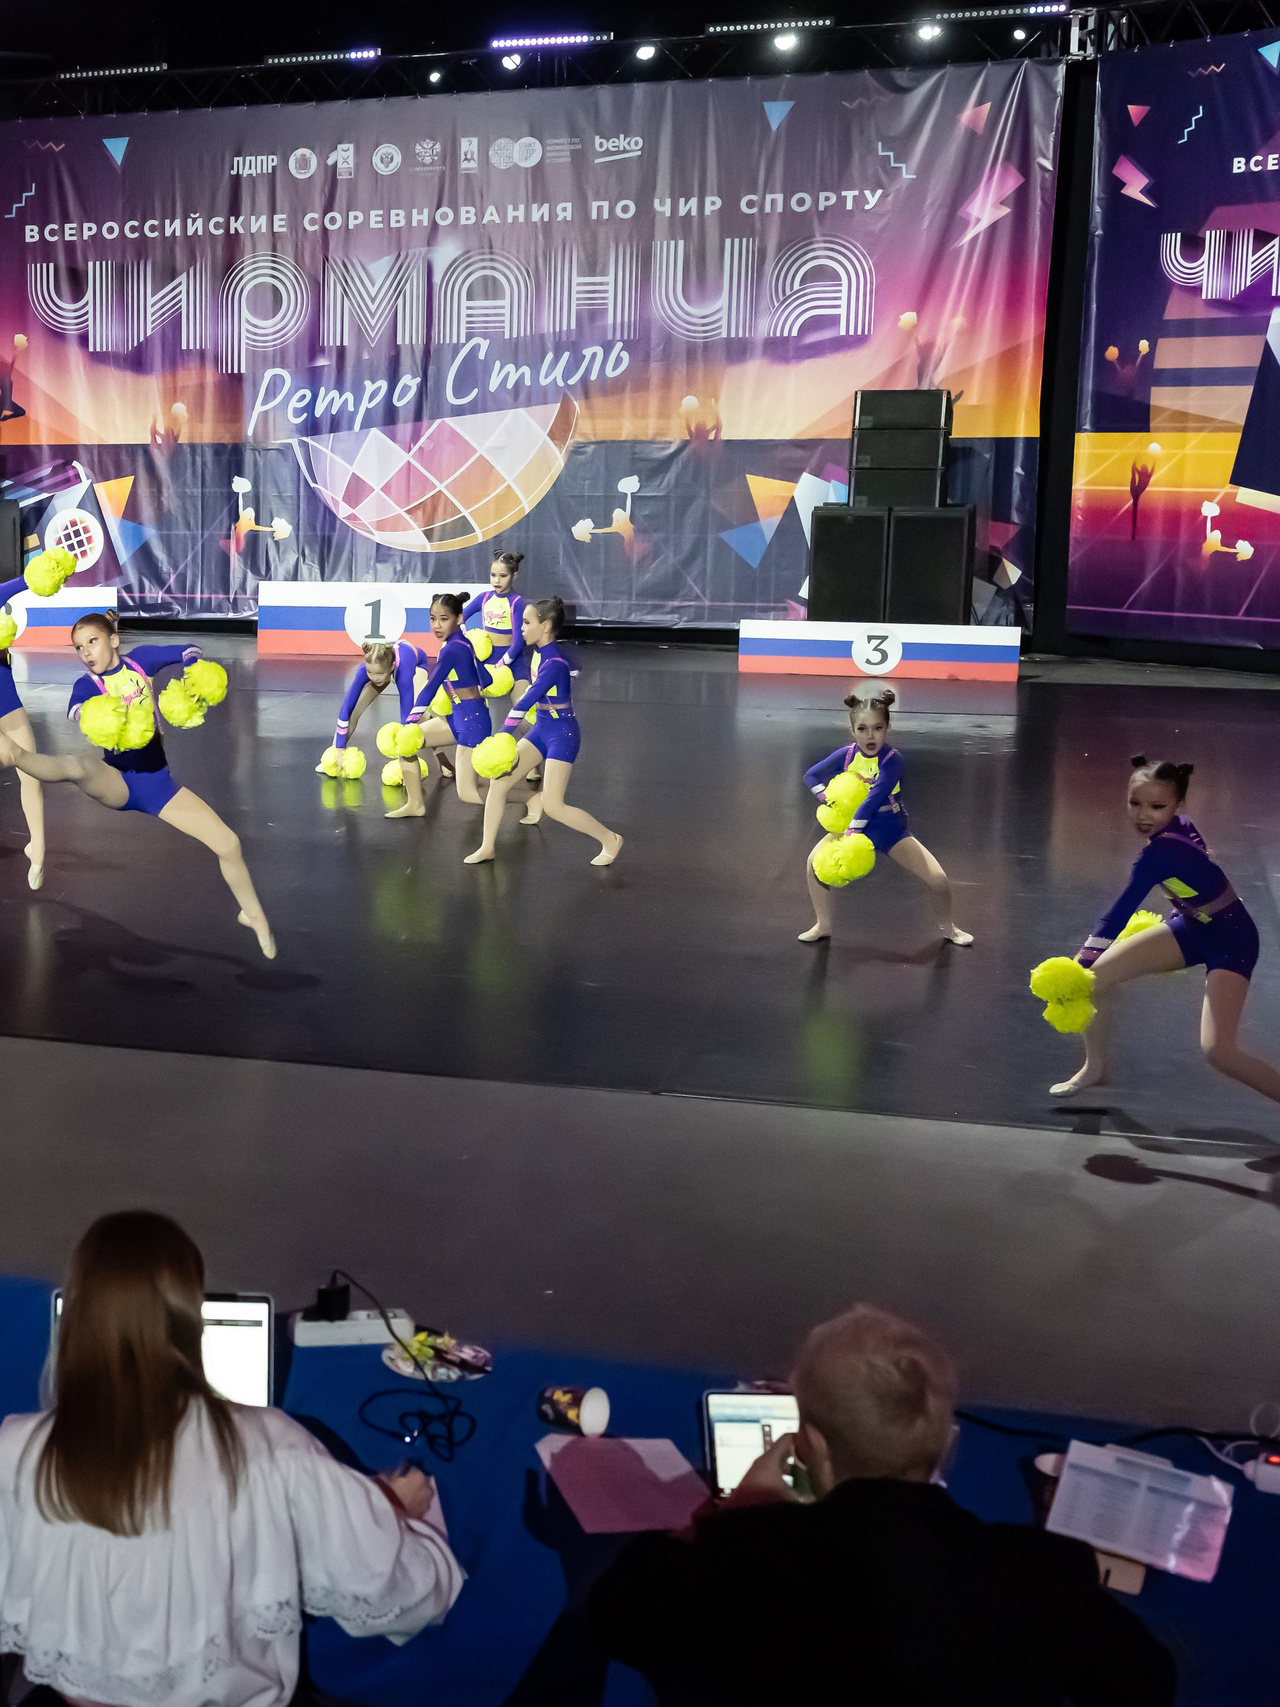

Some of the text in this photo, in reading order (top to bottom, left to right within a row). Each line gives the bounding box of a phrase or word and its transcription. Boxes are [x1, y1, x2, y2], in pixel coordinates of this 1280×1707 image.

[594, 134, 644, 152] beko
[230, 155, 277, 177] ЛДПР
[1232, 153, 1280, 174] ВСЕ
[24, 189, 884, 243] ВСЕРОССИЙСКИЕ СОРЕВНОВАНИЯ ПО ЧИР СПОРТУ
[247, 336, 630, 437] Ретро Стиль
[364, 599, 386, 639] 1
[864, 635, 889, 666] 3
